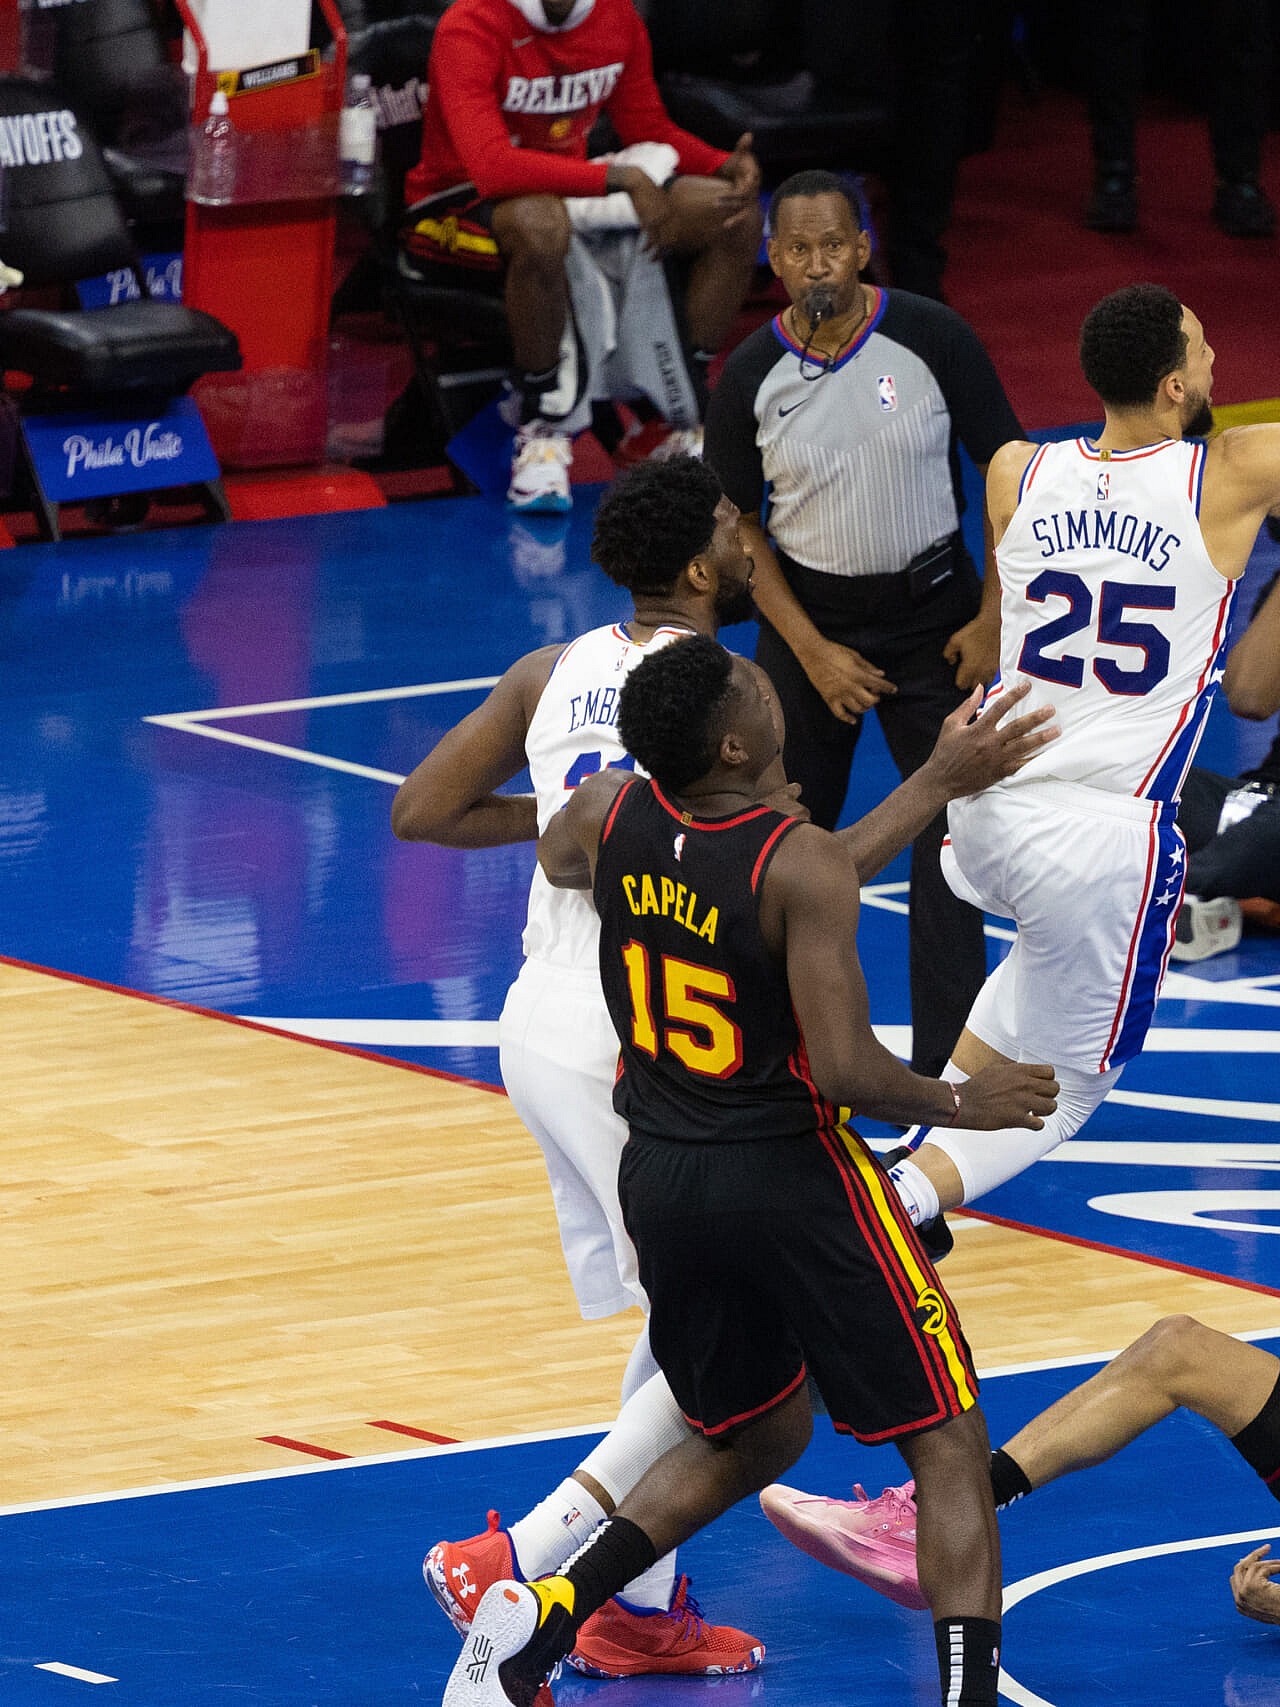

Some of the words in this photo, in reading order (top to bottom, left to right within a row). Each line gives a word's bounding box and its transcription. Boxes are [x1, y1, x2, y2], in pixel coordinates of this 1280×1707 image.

[63, 434, 126, 478] Phila
[124, 422, 183, 467] Unite
[1032, 509, 1181, 572] SIMMONS
[1017, 568, 1176, 697] 25
[622, 872, 719, 945] CAPELA
[622, 938, 742, 1081] 15
